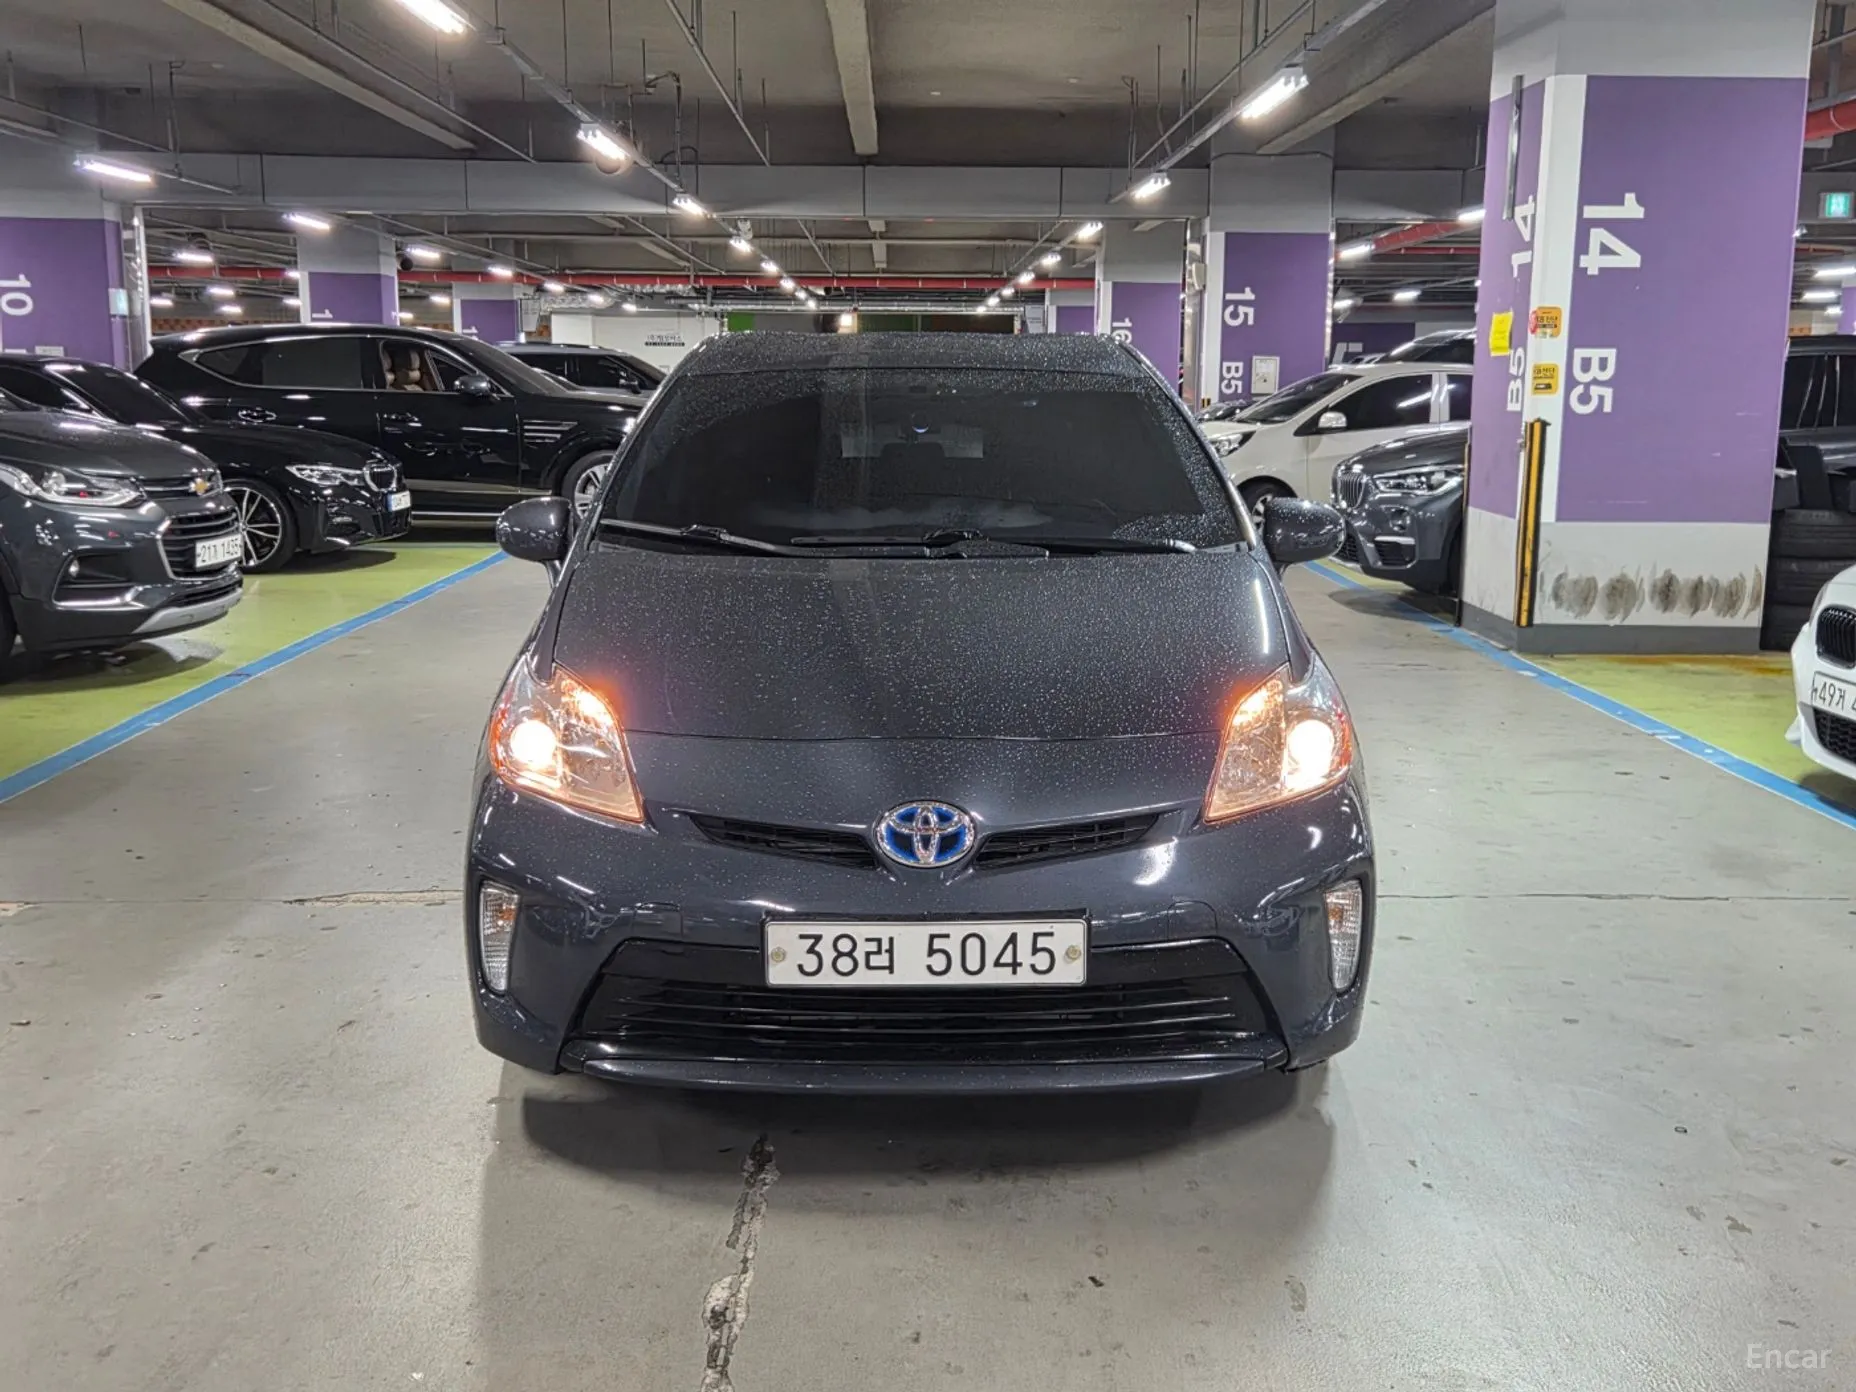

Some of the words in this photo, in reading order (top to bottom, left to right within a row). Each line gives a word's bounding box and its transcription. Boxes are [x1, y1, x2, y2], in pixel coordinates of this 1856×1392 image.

[1579, 193, 1645, 275] 14
[0, 273, 34, 316] 10
[1223, 287, 1256, 327] 15
[1221, 361, 1244, 394] B5
[1569, 348, 1616, 415] B5
[797, 932, 894, 976] 38러
[925, 931, 1056, 976] 5045
